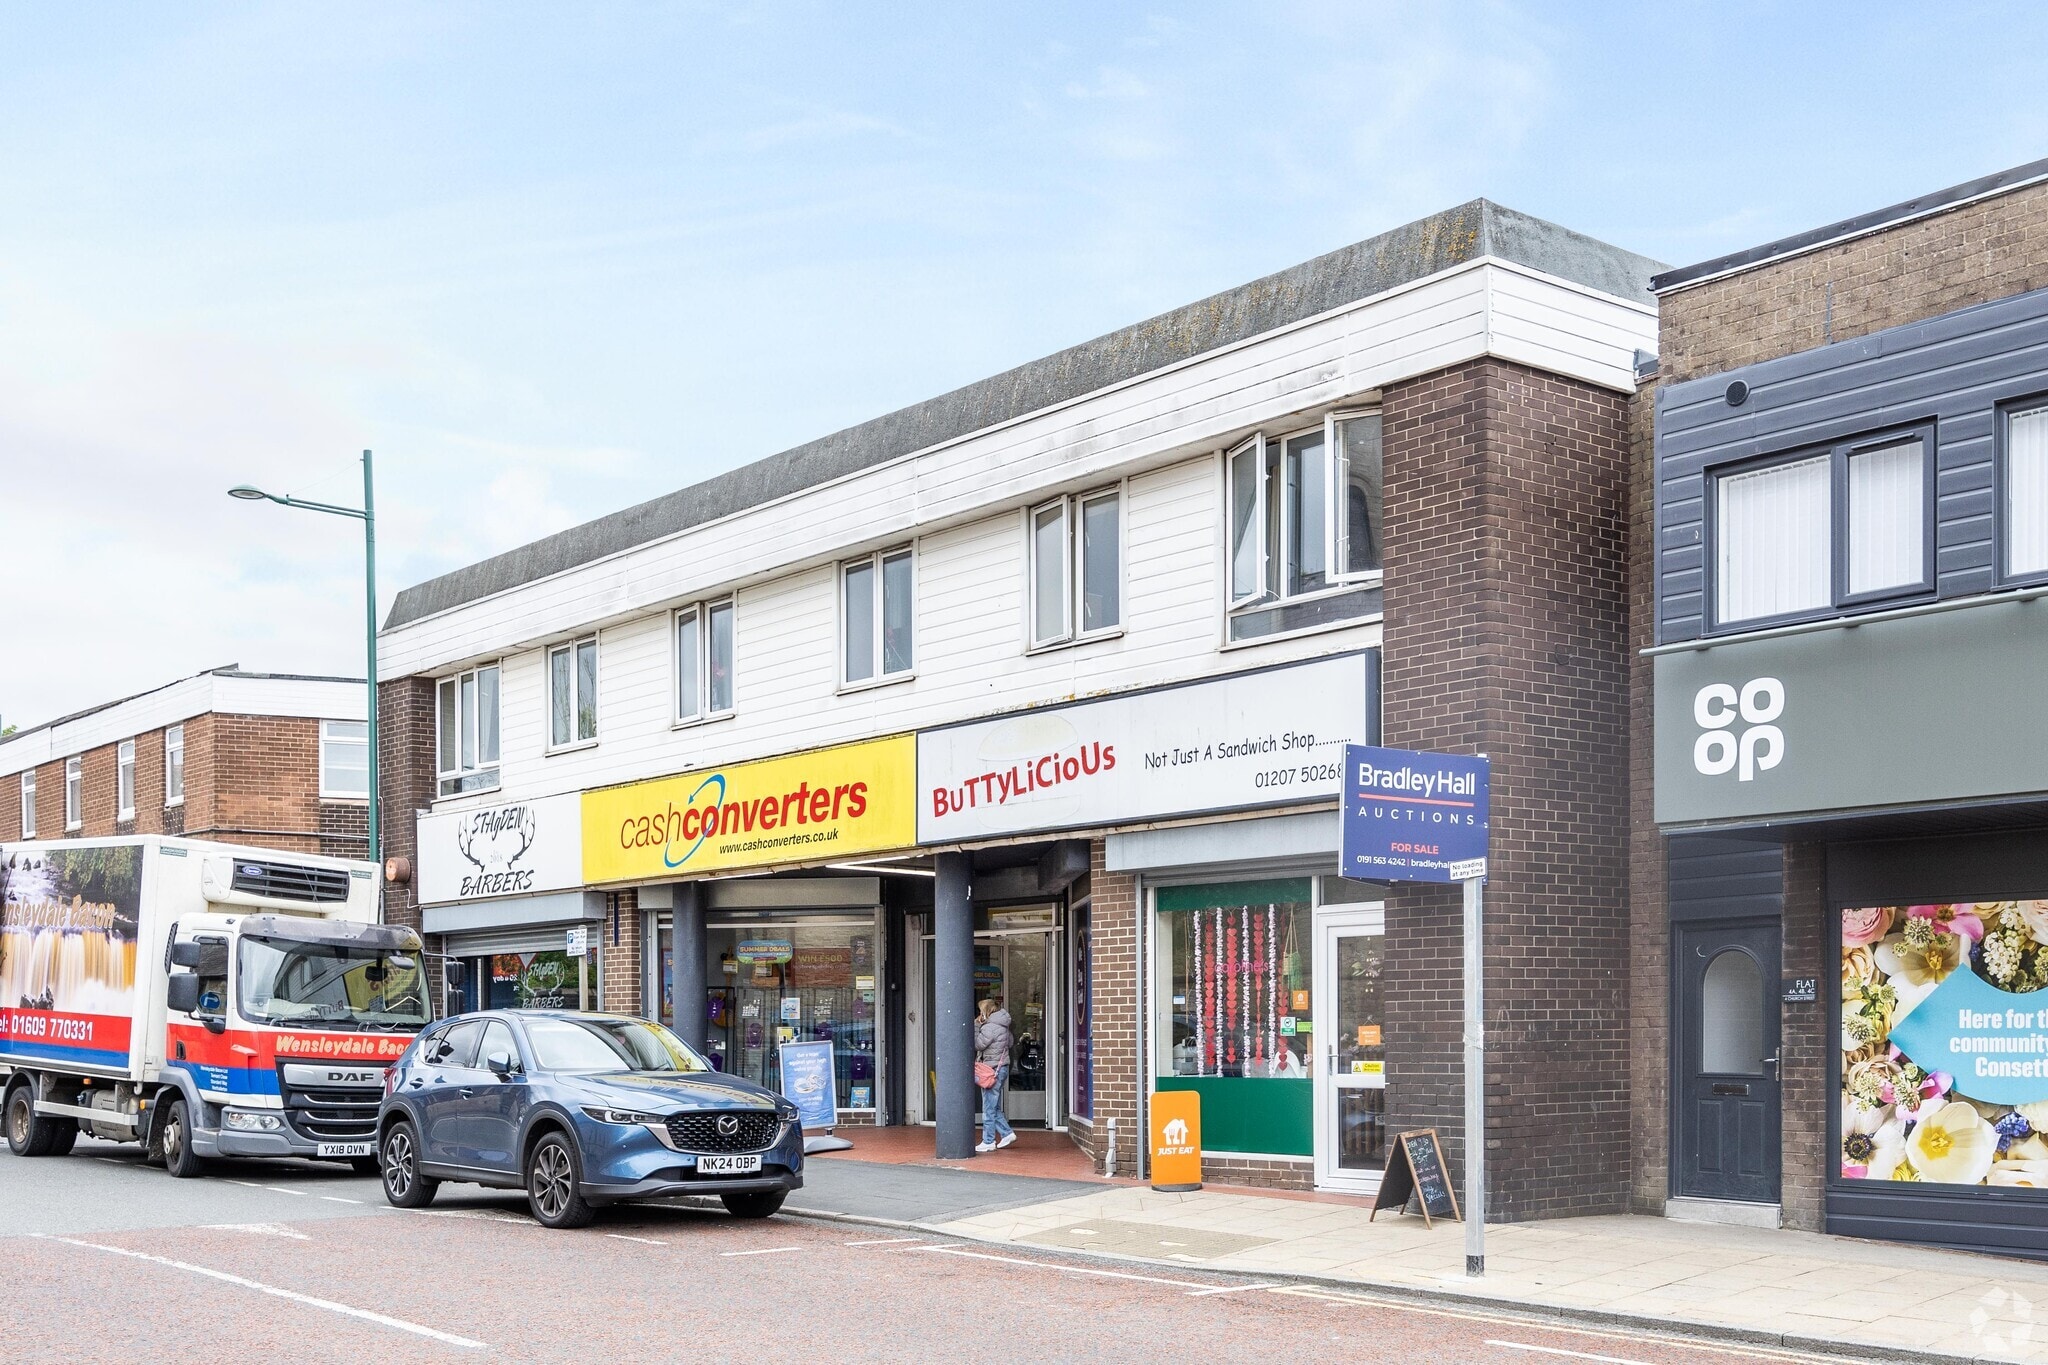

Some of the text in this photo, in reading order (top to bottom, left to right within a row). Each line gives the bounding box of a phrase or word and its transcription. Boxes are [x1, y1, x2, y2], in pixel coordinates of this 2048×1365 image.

[1145, 752, 1168, 769] Not
[1171, 747, 1200, 766] Just
[1203, 745, 1213, 760] A
[1217, 734, 1277, 759] Sandwich
[1255, 769, 1296, 788] 01207
[1358, 806, 1475, 825] AUCTIONS
[719, 827, 839, 855] www.cashconverters.co.uk
[1391, 842, 1439, 854] FOR SALE
[1356, 855, 1372, 864] 0191
[1373, 856, 1387, 865] 563
[1387, 858, 1406, 867] 4242
[1462, 861, 1483, 869] loading
[460, 870, 535, 896] BARBERS
[0, 893, 116, 929] ensleydale Bacon
[1796, 980, 1815, 988] FLAT
[522, 996, 565, 1009] BARBERS
[1959, 1009, 2048, 1029] Here for t
[12, 1015, 46, 1036] 01609
[50, 1018, 93, 1041] 770331
[276, 1035, 375, 1056] Wensleydale
[328, 1072, 374, 1081] DAF
[323, 1145, 365, 1154] YX18 OVN
[1158, 1146, 1195, 1156] JUST EAT
[703, 1157, 756, 1169] NK24 OBP
